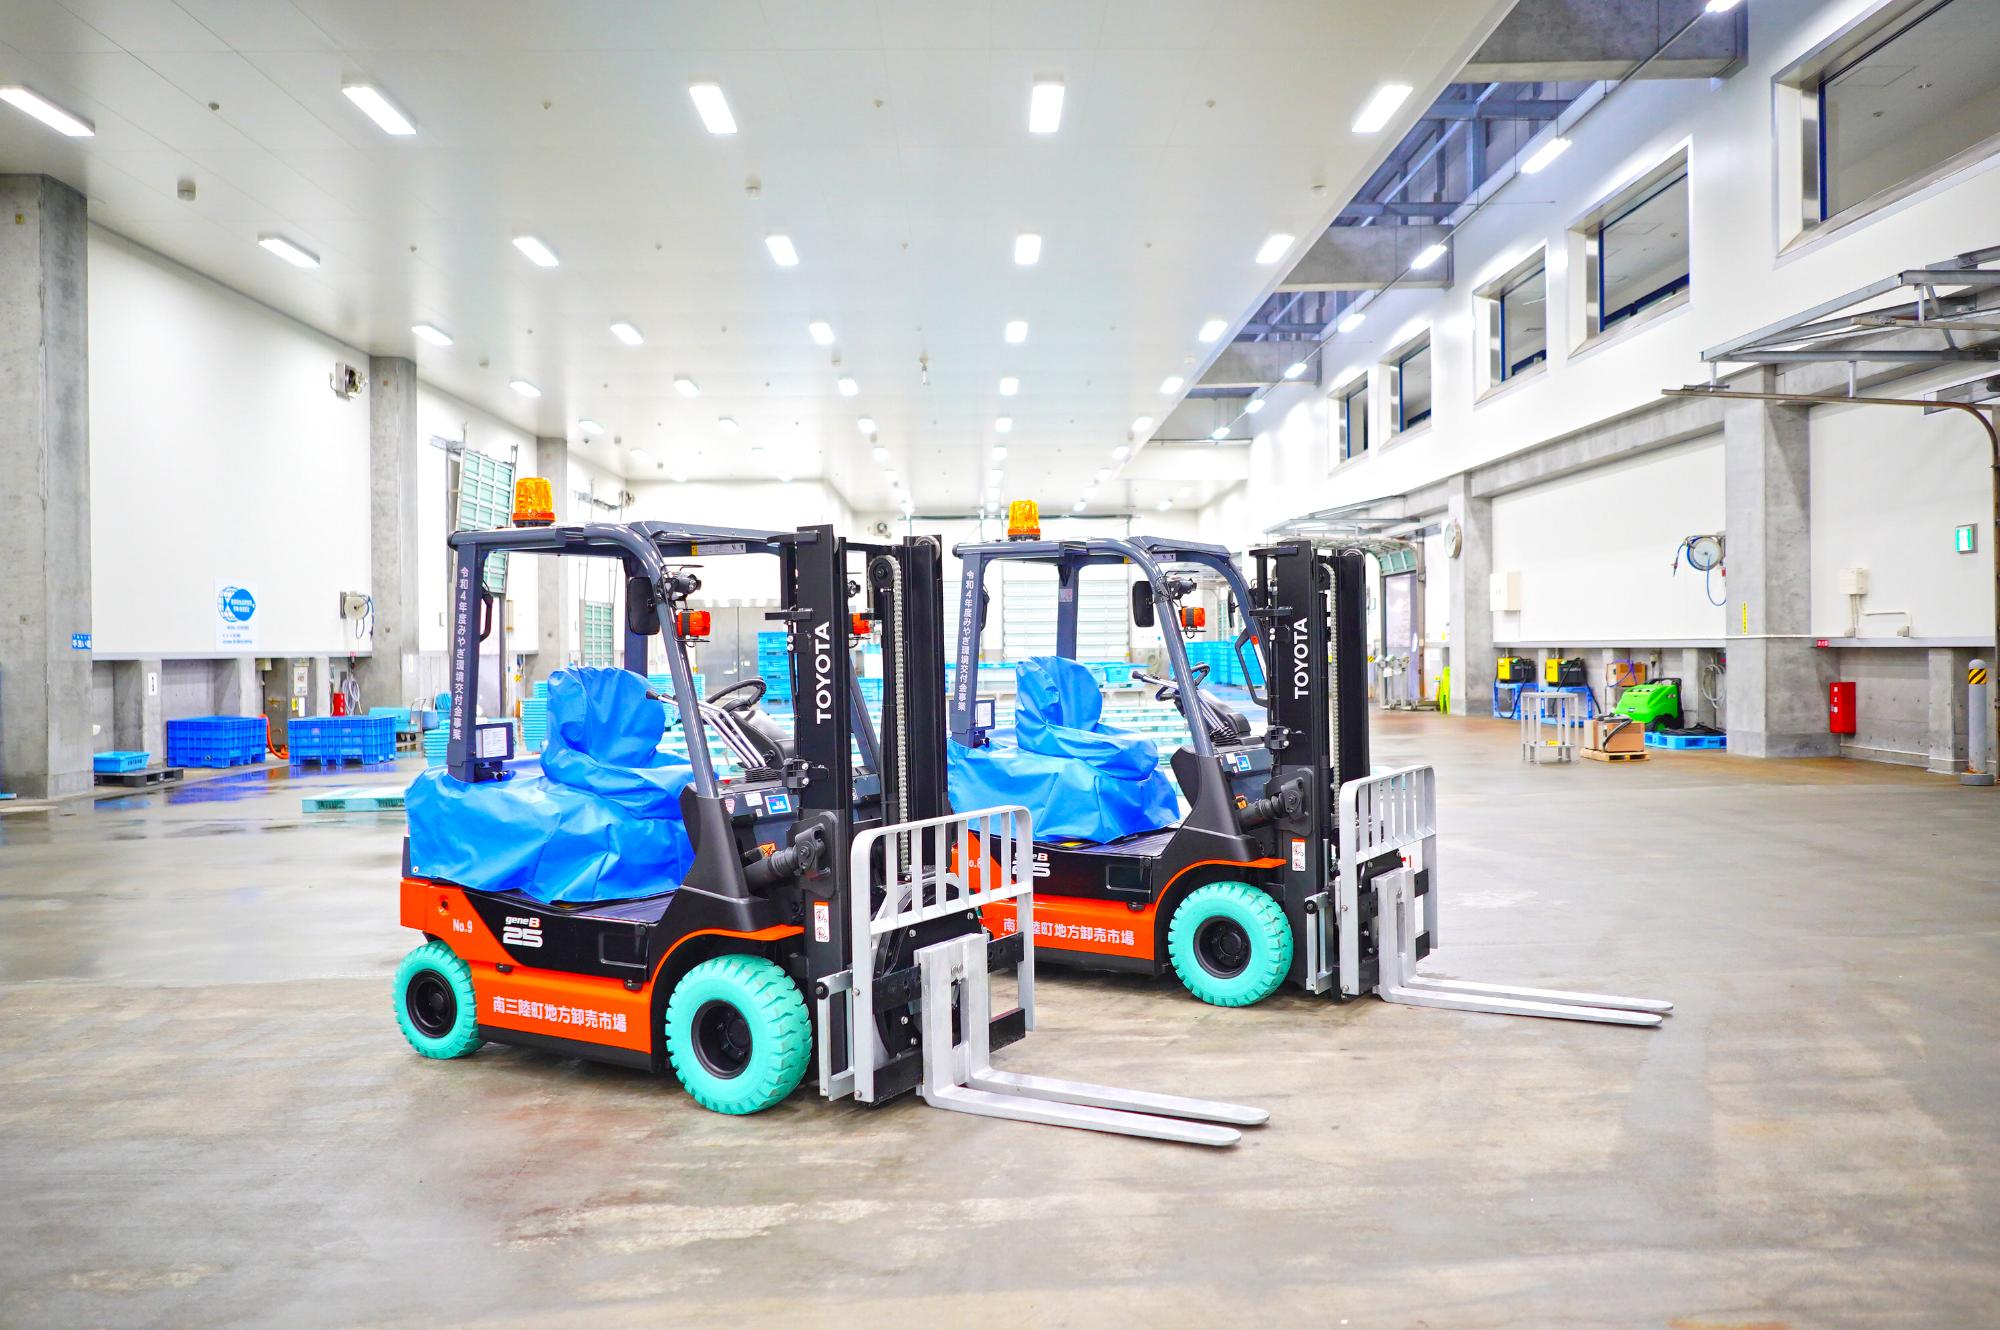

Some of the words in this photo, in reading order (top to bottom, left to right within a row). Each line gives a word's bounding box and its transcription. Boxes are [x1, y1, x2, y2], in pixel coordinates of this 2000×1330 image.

[453, 566, 469, 740] 令和4年度みやぎ環境交付金事業
[957, 570, 975, 711] 令和4年度みやぎ環境交付金事業
[1293, 617, 1309, 699] TOYOTA
[814, 621, 832, 725] TOYOTA
[452, 918, 473, 934] No.9
[502, 926, 544, 948] 25
[1003, 918, 1135, 946] 南陸町地方卸売市場
[493, 996, 627, 1033] 南三陸町地方卸売市場
